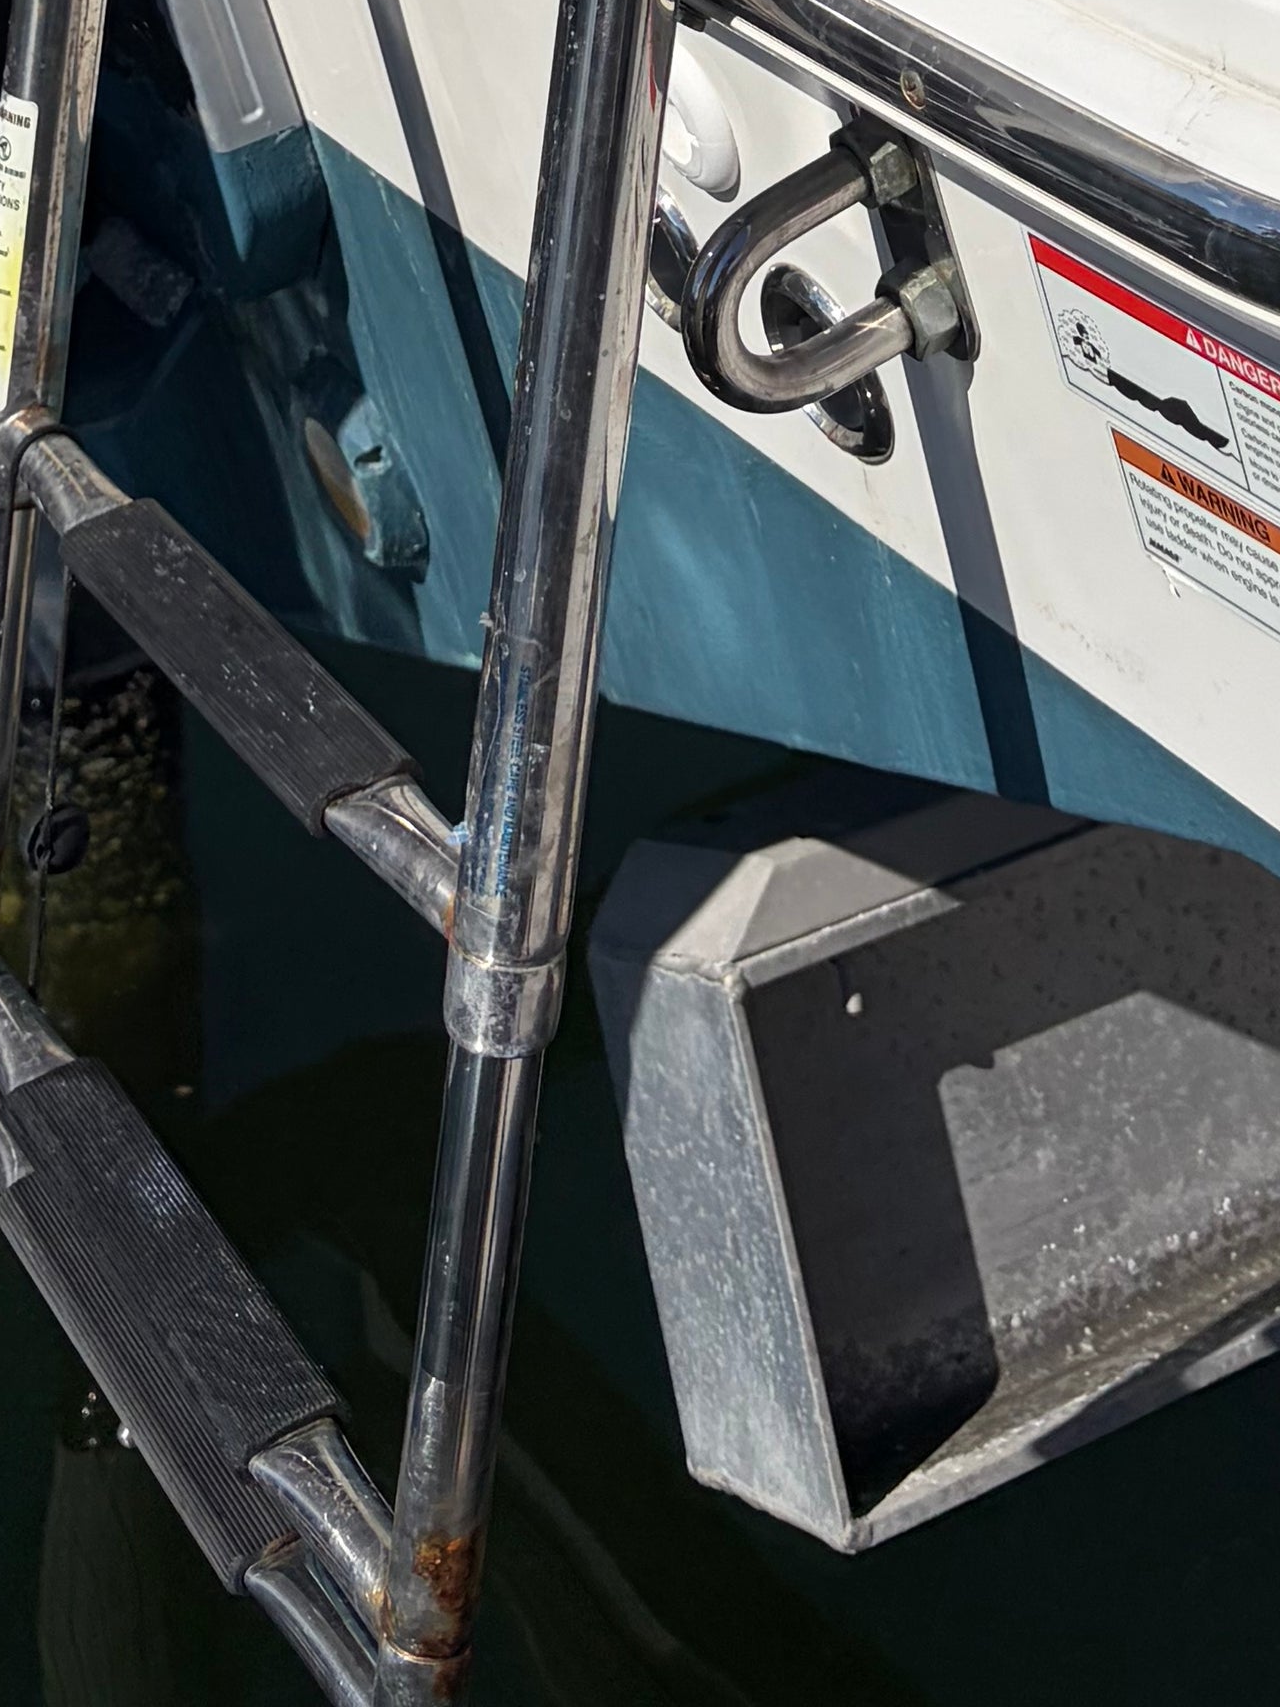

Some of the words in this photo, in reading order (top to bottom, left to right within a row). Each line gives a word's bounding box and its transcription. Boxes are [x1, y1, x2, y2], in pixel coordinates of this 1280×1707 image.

[1129, 472, 1172, 509] Rotating
[1173, 501, 1217, 534] propeller
[1220, 530, 1243, 552] may
[1245, 545, 1278, 572] cause
[1138, 494, 1166, 521] injury
[1169, 515, 1179, 527] or
[1182, 523, 1214, 549] death.
[1216, 541, 1233, 561] Do
[1235, 556, 1253, 573] not
[1176, 470, 1271, 544] WARNING
[1145, 516, 1163, 534] use
[1165, 527, 1197, 555] ladder
[1200, 551, 1229, 574] when
[1231, 570, 1267, 599] engine
[1268, 591, 1279, 607] is
